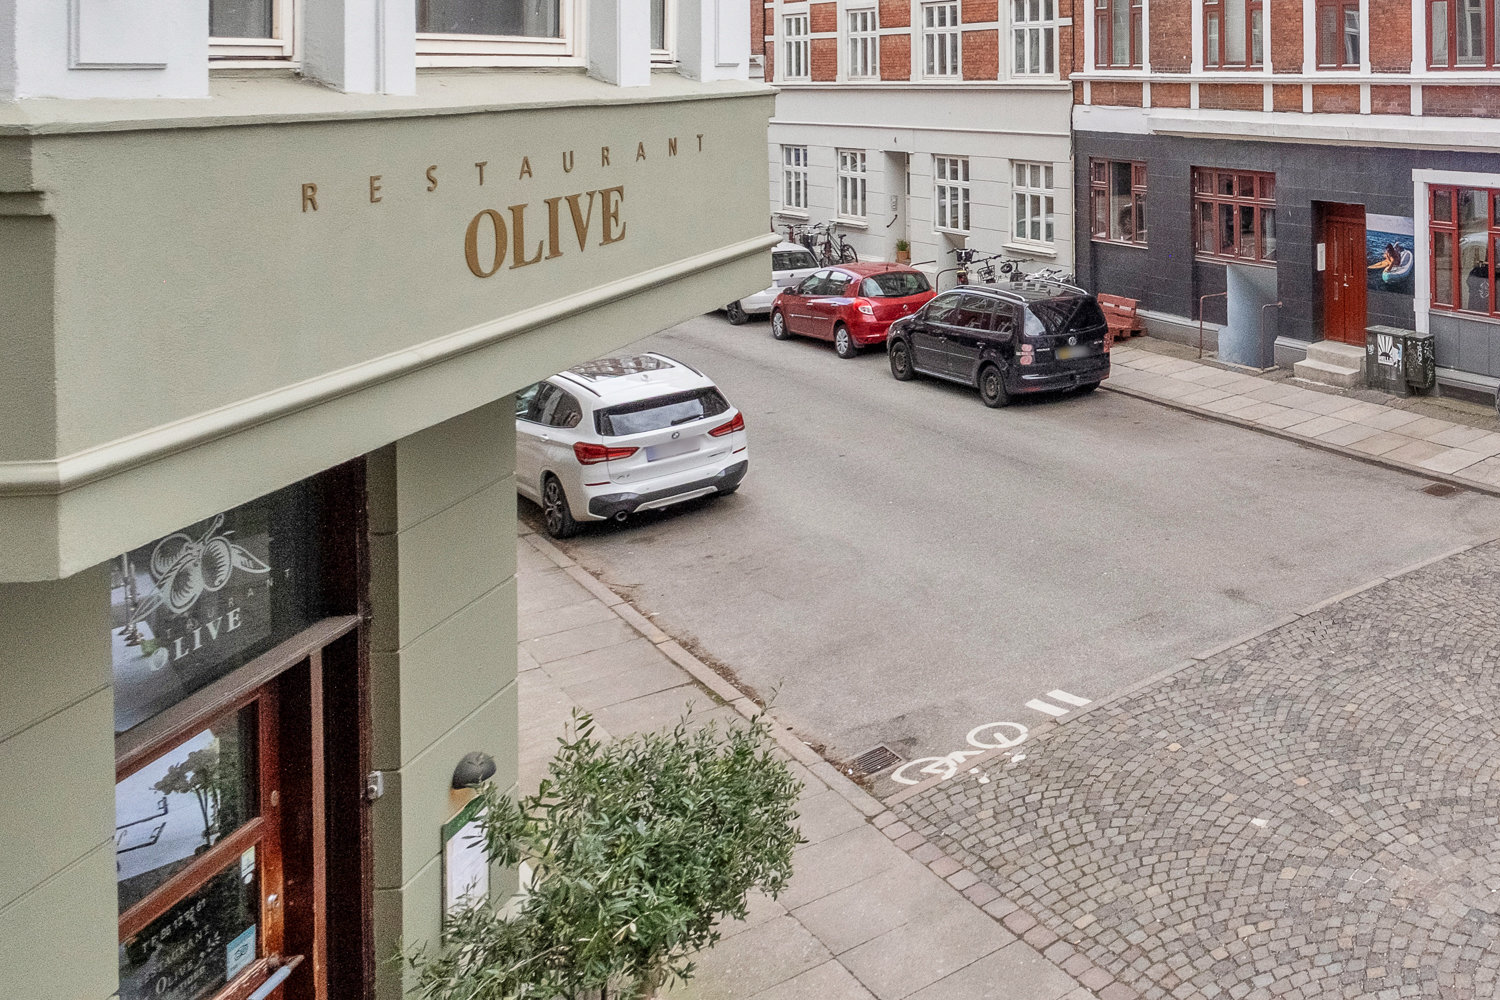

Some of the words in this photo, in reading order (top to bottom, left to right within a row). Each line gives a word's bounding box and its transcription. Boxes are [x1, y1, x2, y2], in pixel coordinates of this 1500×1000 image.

[301, 133, 704, 213] RESTAURANT
[464, 185, 627, 279] OLIVE
[151, 607, 242, 672] OLIVE
